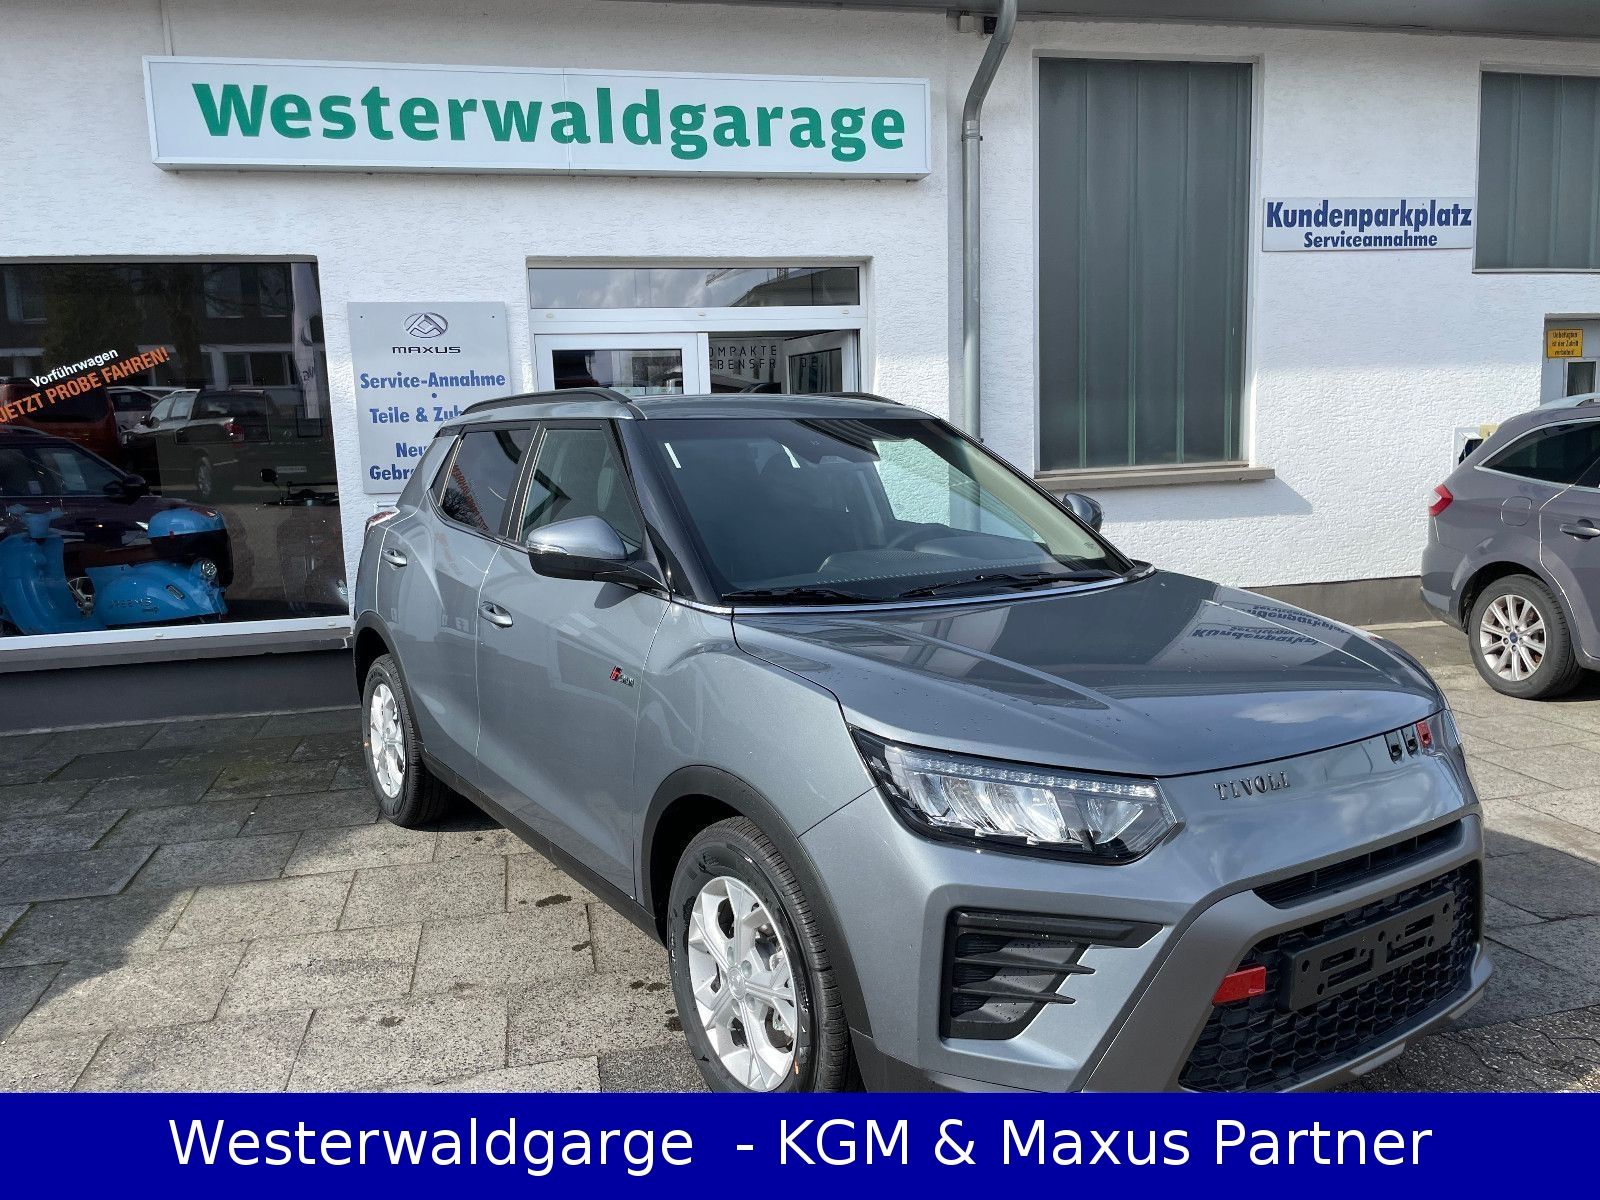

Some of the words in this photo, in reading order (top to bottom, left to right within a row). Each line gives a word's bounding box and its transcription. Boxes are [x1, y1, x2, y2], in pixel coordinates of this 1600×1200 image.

[192, 83, 905, 162] Westerwaldgarage
[1266, 199, 1473, 232] Kundenparkplatz
[1304, 229, 1438, 248] Serviceannahme
[392, 346, 461, 354] MAXUS
[29, 350, 119, 388] Vorführwagen
[359, 370, 506, 389] Service-Annahme
[0, 392, 44, 423] JETZT
[45, 371, 102, 404] PROBE
[101, 346, 171, 384] FAHREN!
[369, 406, 410, 424] Teile
[415, 406, 429, 423] &
[369, 464, 415, 481] Gebr
[1213, 771, 1291, 801] TIVOLI
